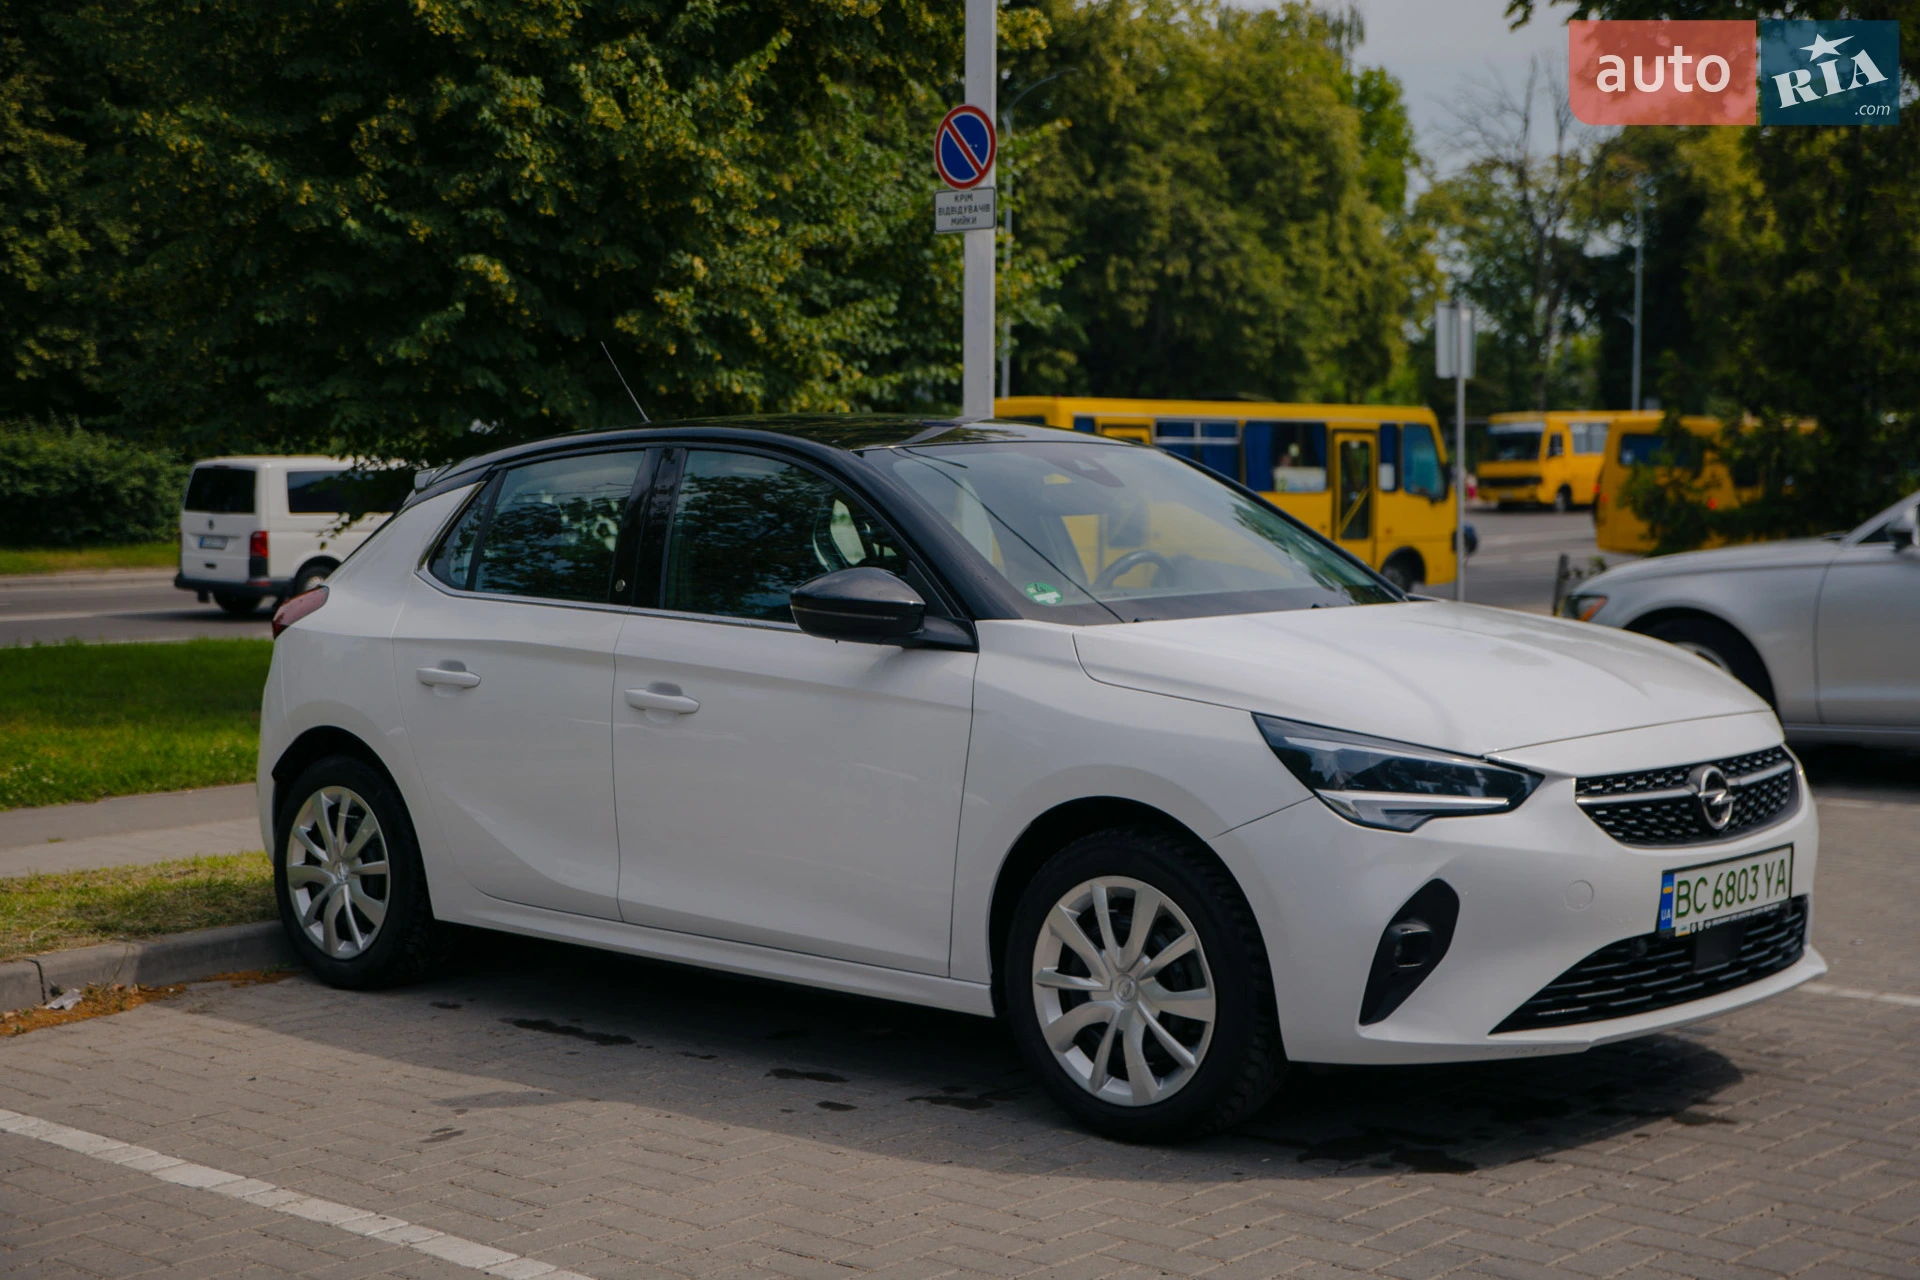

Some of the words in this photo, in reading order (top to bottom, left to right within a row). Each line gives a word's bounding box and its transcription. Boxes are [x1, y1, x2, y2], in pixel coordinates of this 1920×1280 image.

[954, 193, 973, 202] КРІМ
[1675, 877, 1708, 918] BC
[1712, 864, 1758, 909] 6803
[1764, 859, 1785, 898] YA
[1660, 909, 1671, 921] UA
